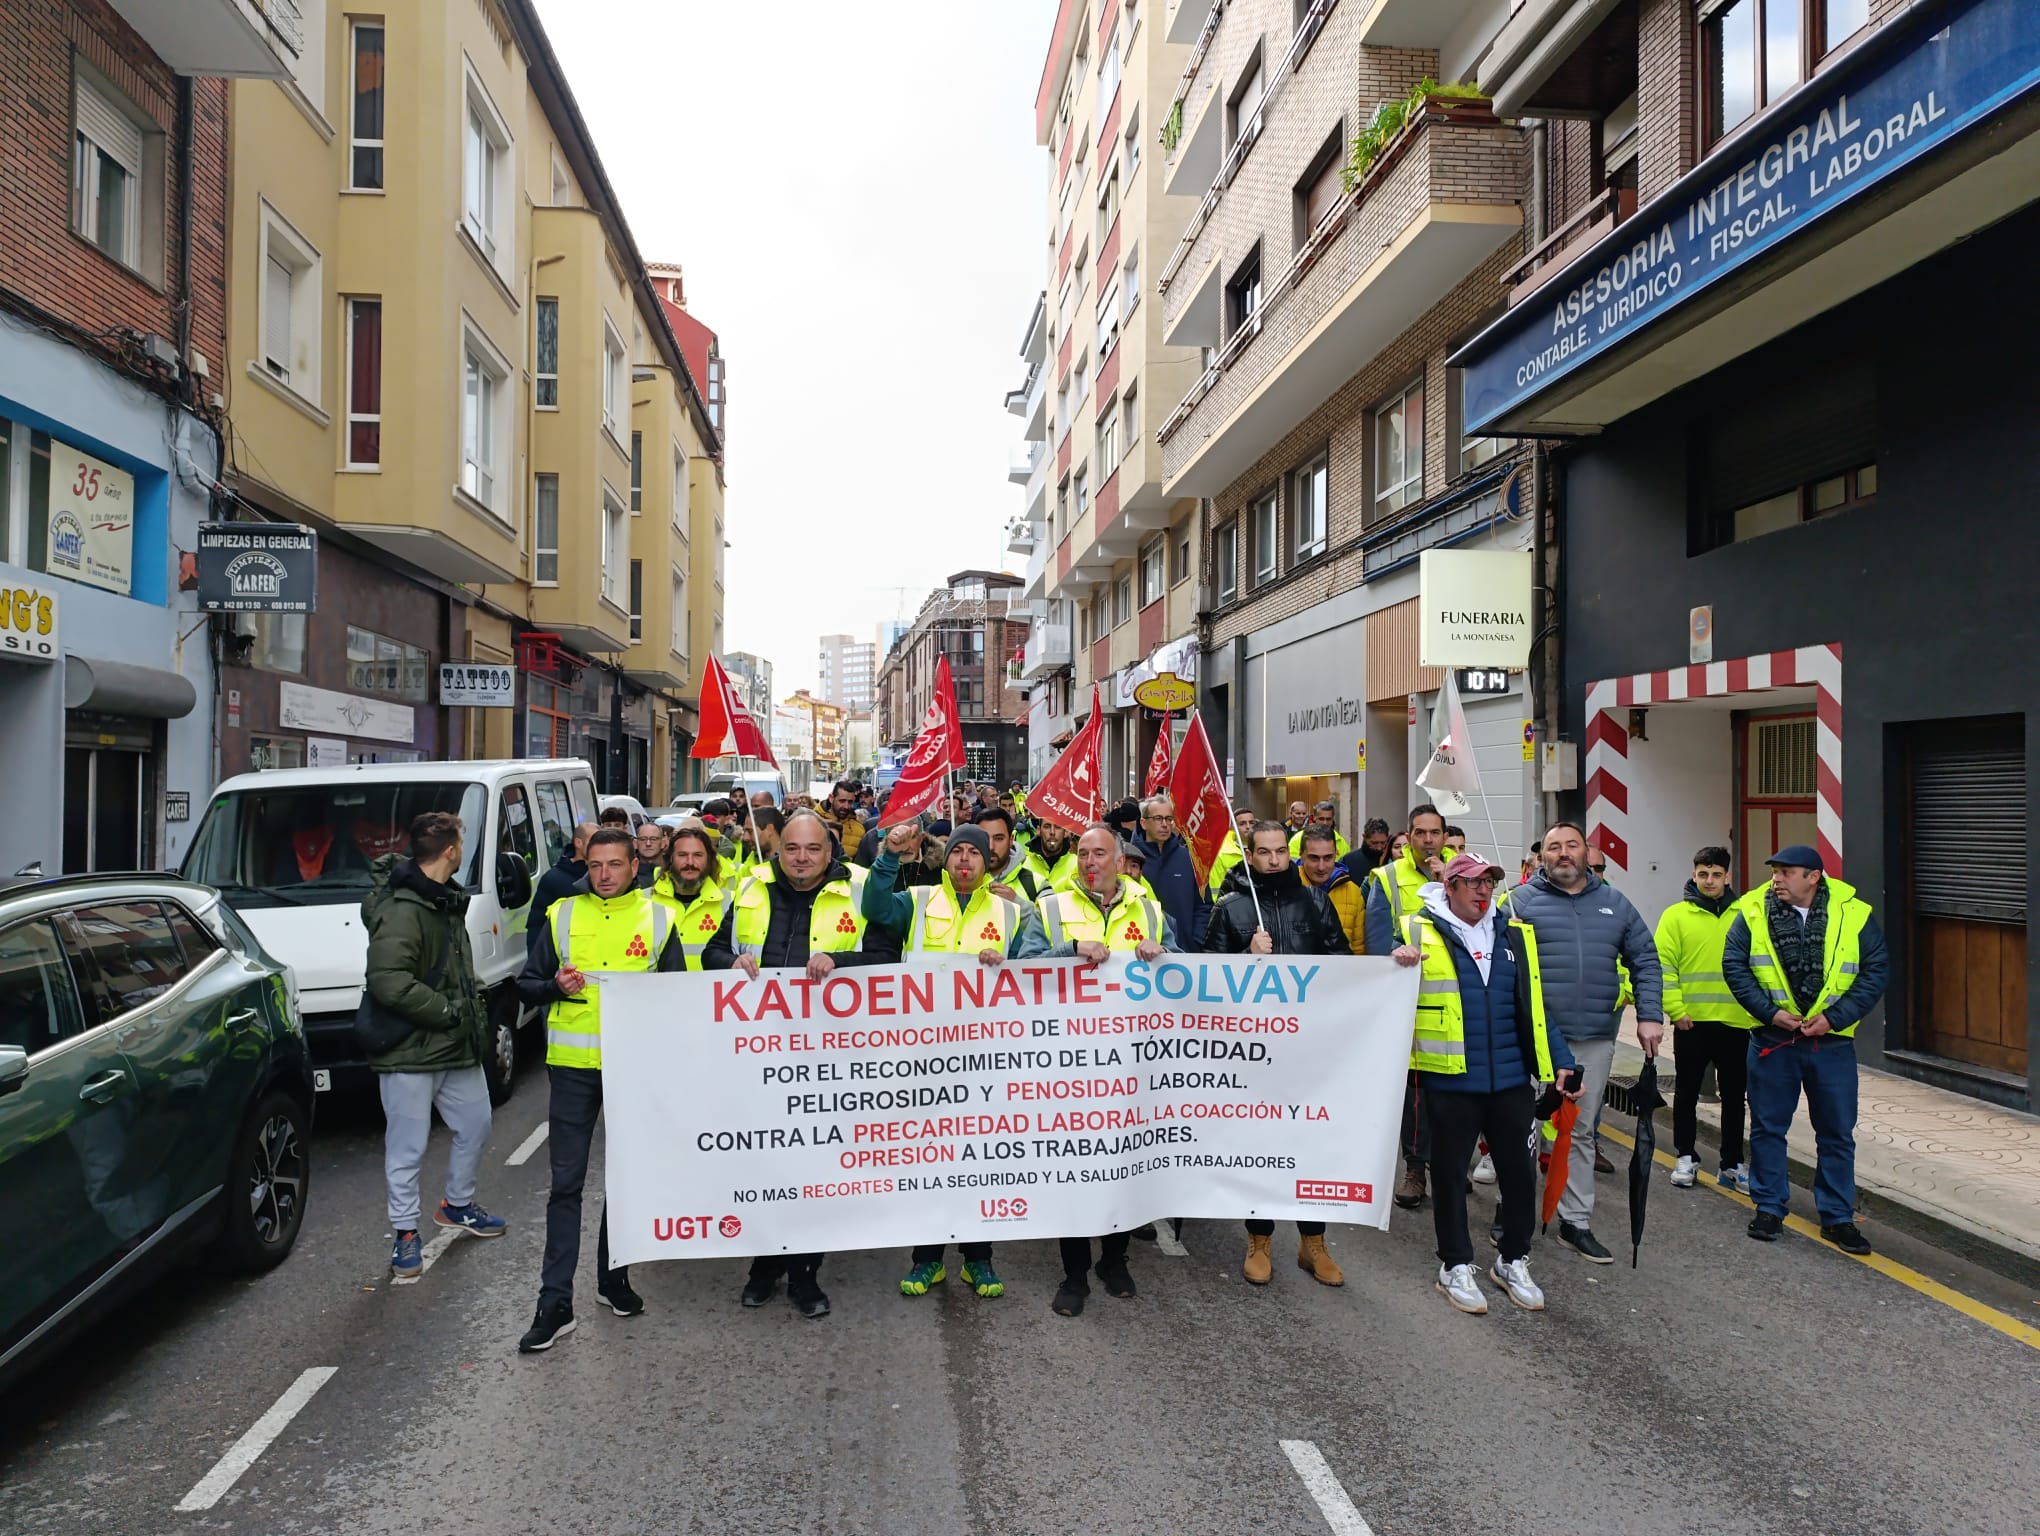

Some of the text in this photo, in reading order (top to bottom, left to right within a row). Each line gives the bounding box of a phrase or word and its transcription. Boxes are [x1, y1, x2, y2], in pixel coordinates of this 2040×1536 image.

[1553, 95, 1861, 335] ASESORIA INTEGRAL
[1517, 324, 1592, 387] CONTABLE,
[1599, 263, 1682, 335] JURIDICO
[1710, 192, 1797, 262] FISCAL,
[1809, 91, 1946, 198] LABORAL
[73, 463, 102, 501] 35
[56, 531, 79, 554] GARFER
[201, 535, 312, 549] LIMPIEZAS EN GENERAL
[229, 556, 282, 575] LIMPIEZAS
[236, 574, 275, 592] GARFER
[1441, 611, 1525, 625] FUNERARIA
[1451, 632, 1515, 642] LA MONTAÑESA
[442, 668, 511, 690] TATTOO
[1139, 687, 1194, 702] Casa Bella
[1288, 696, 1362, 734] LA MONTAÑESA
[166, 802, 188, 819] GARFER
[714, 960, 1320, 1022] KATOEN NATIE-SOLVAY
[735, 1012, 1299, 1054] POR EL RECONOCIMIENTO DE NUESTROS DERECHOS
[763, 1035, 1272, 1085] POR EL RECONOCIMIENTO DE LA TÓXICIDAD,
[787, 1072, 1248, 1115] PELIGROSIDAD Y PENOSIDAD LABORAL.
[697, 1100, 1329, 1151] CONTRA LA PRECARIEDAD LABORAL, LA COACCIÓN Y LA
[840, 1126, 1198, 1169] OPRESIÓN A LOS TRABAJADORES.
[734, 1154, 1295, 1203] NO MAS RECORTES EN LA SEGURIDAD Y LA SALUD DE LOS TRABAJADORES
[1299, 1183, 1349, 1198] CCOO
[980, 1198, 1028, 1218] USO
[654, 1216, 713, 1241] UGT
